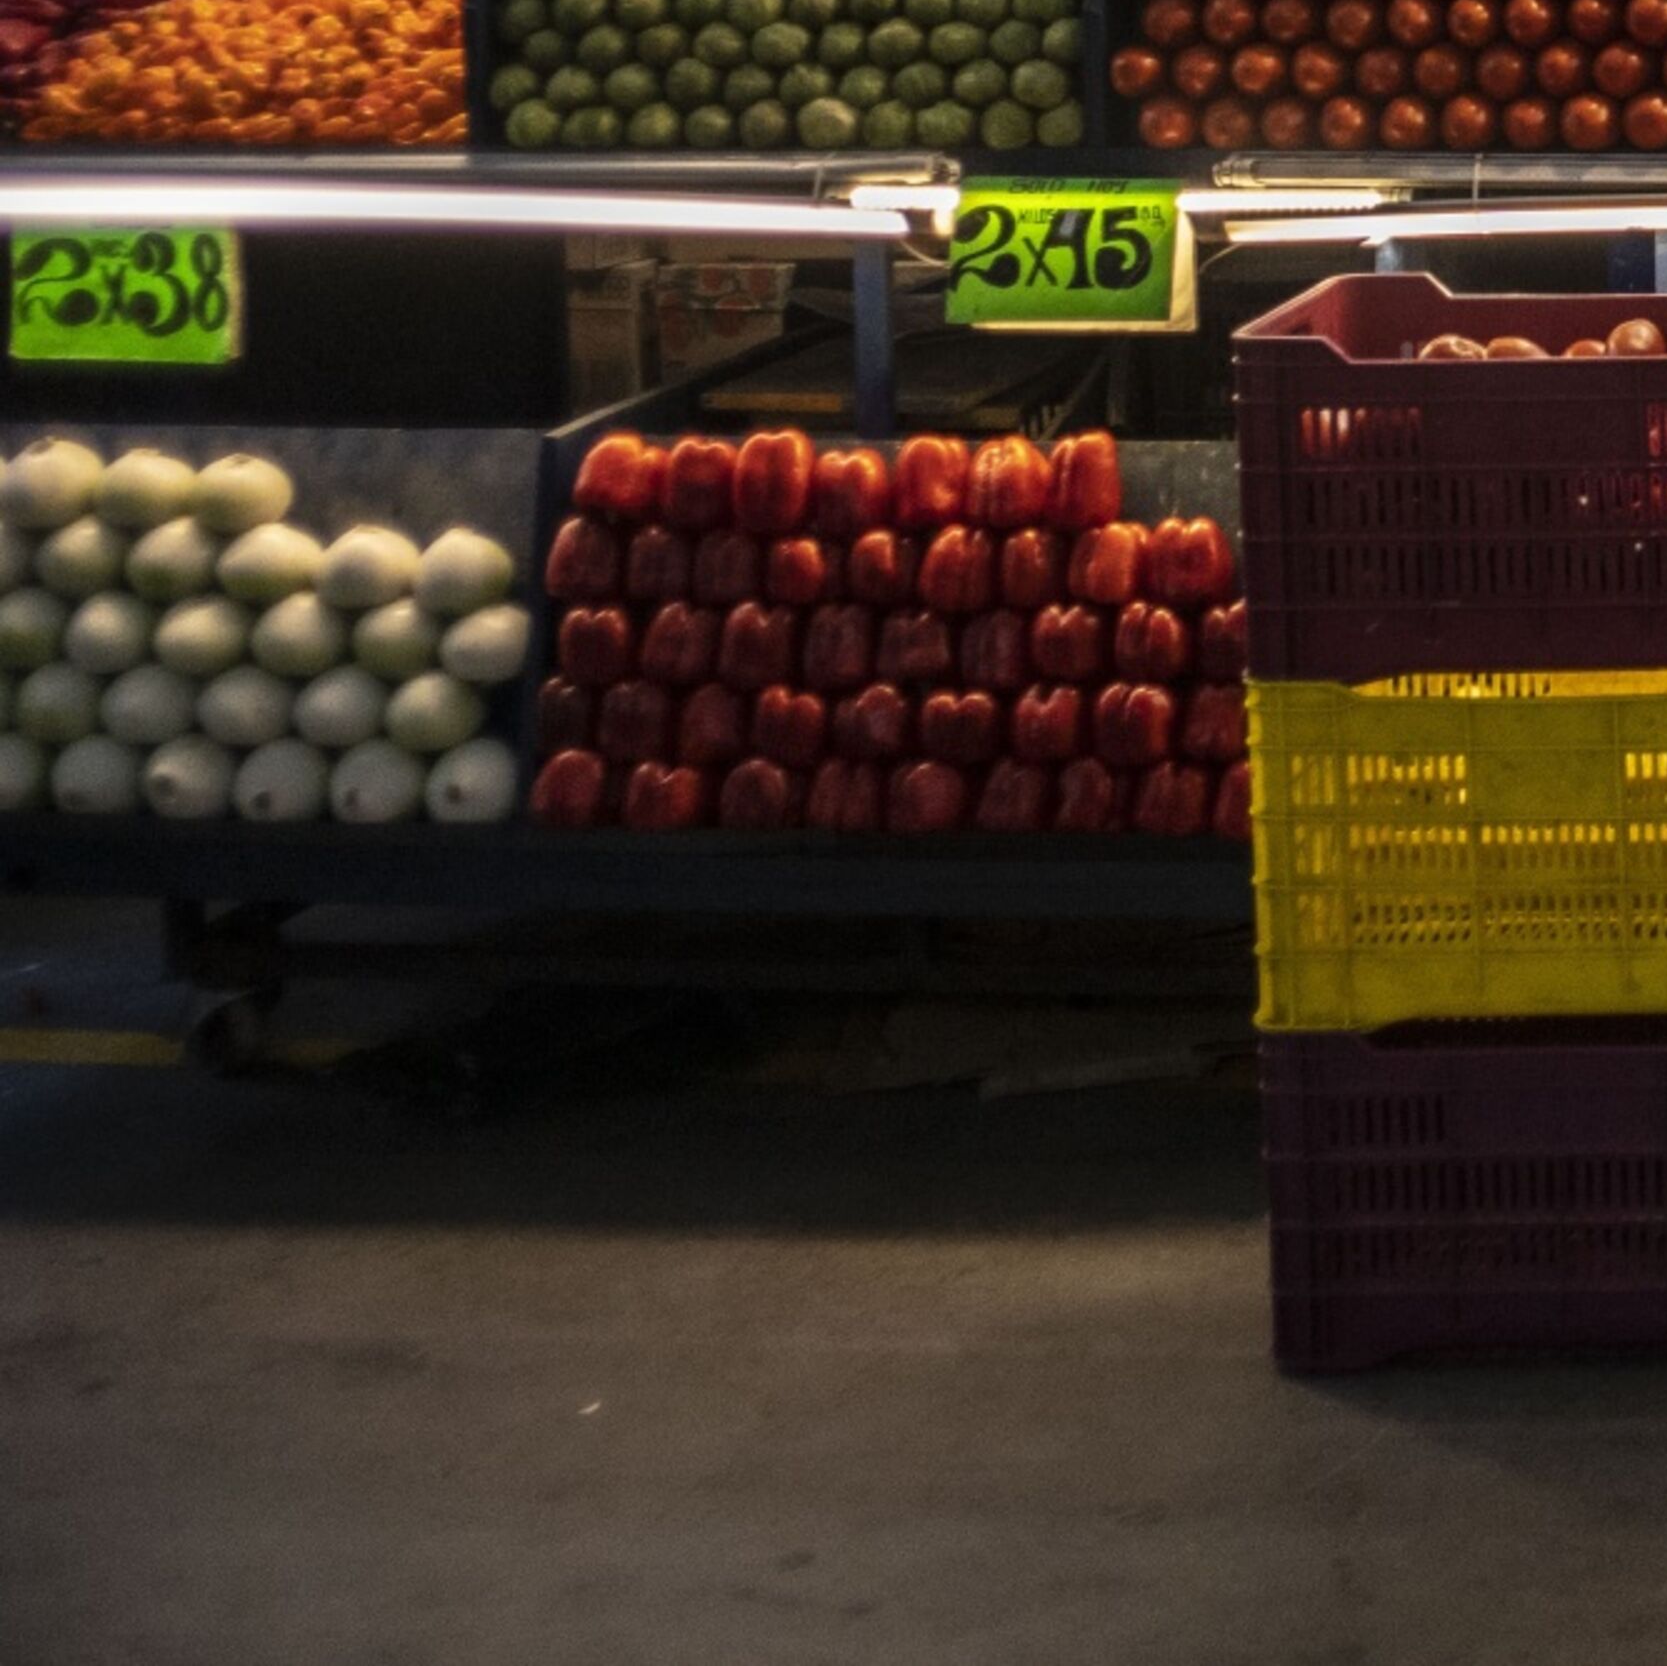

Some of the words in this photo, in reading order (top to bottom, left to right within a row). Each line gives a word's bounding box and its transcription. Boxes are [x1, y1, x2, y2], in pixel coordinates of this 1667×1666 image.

[16, 237, 100, 327] 2
[128, 230, 229, 339] 38
[950, 204, 1020, 292] 2
